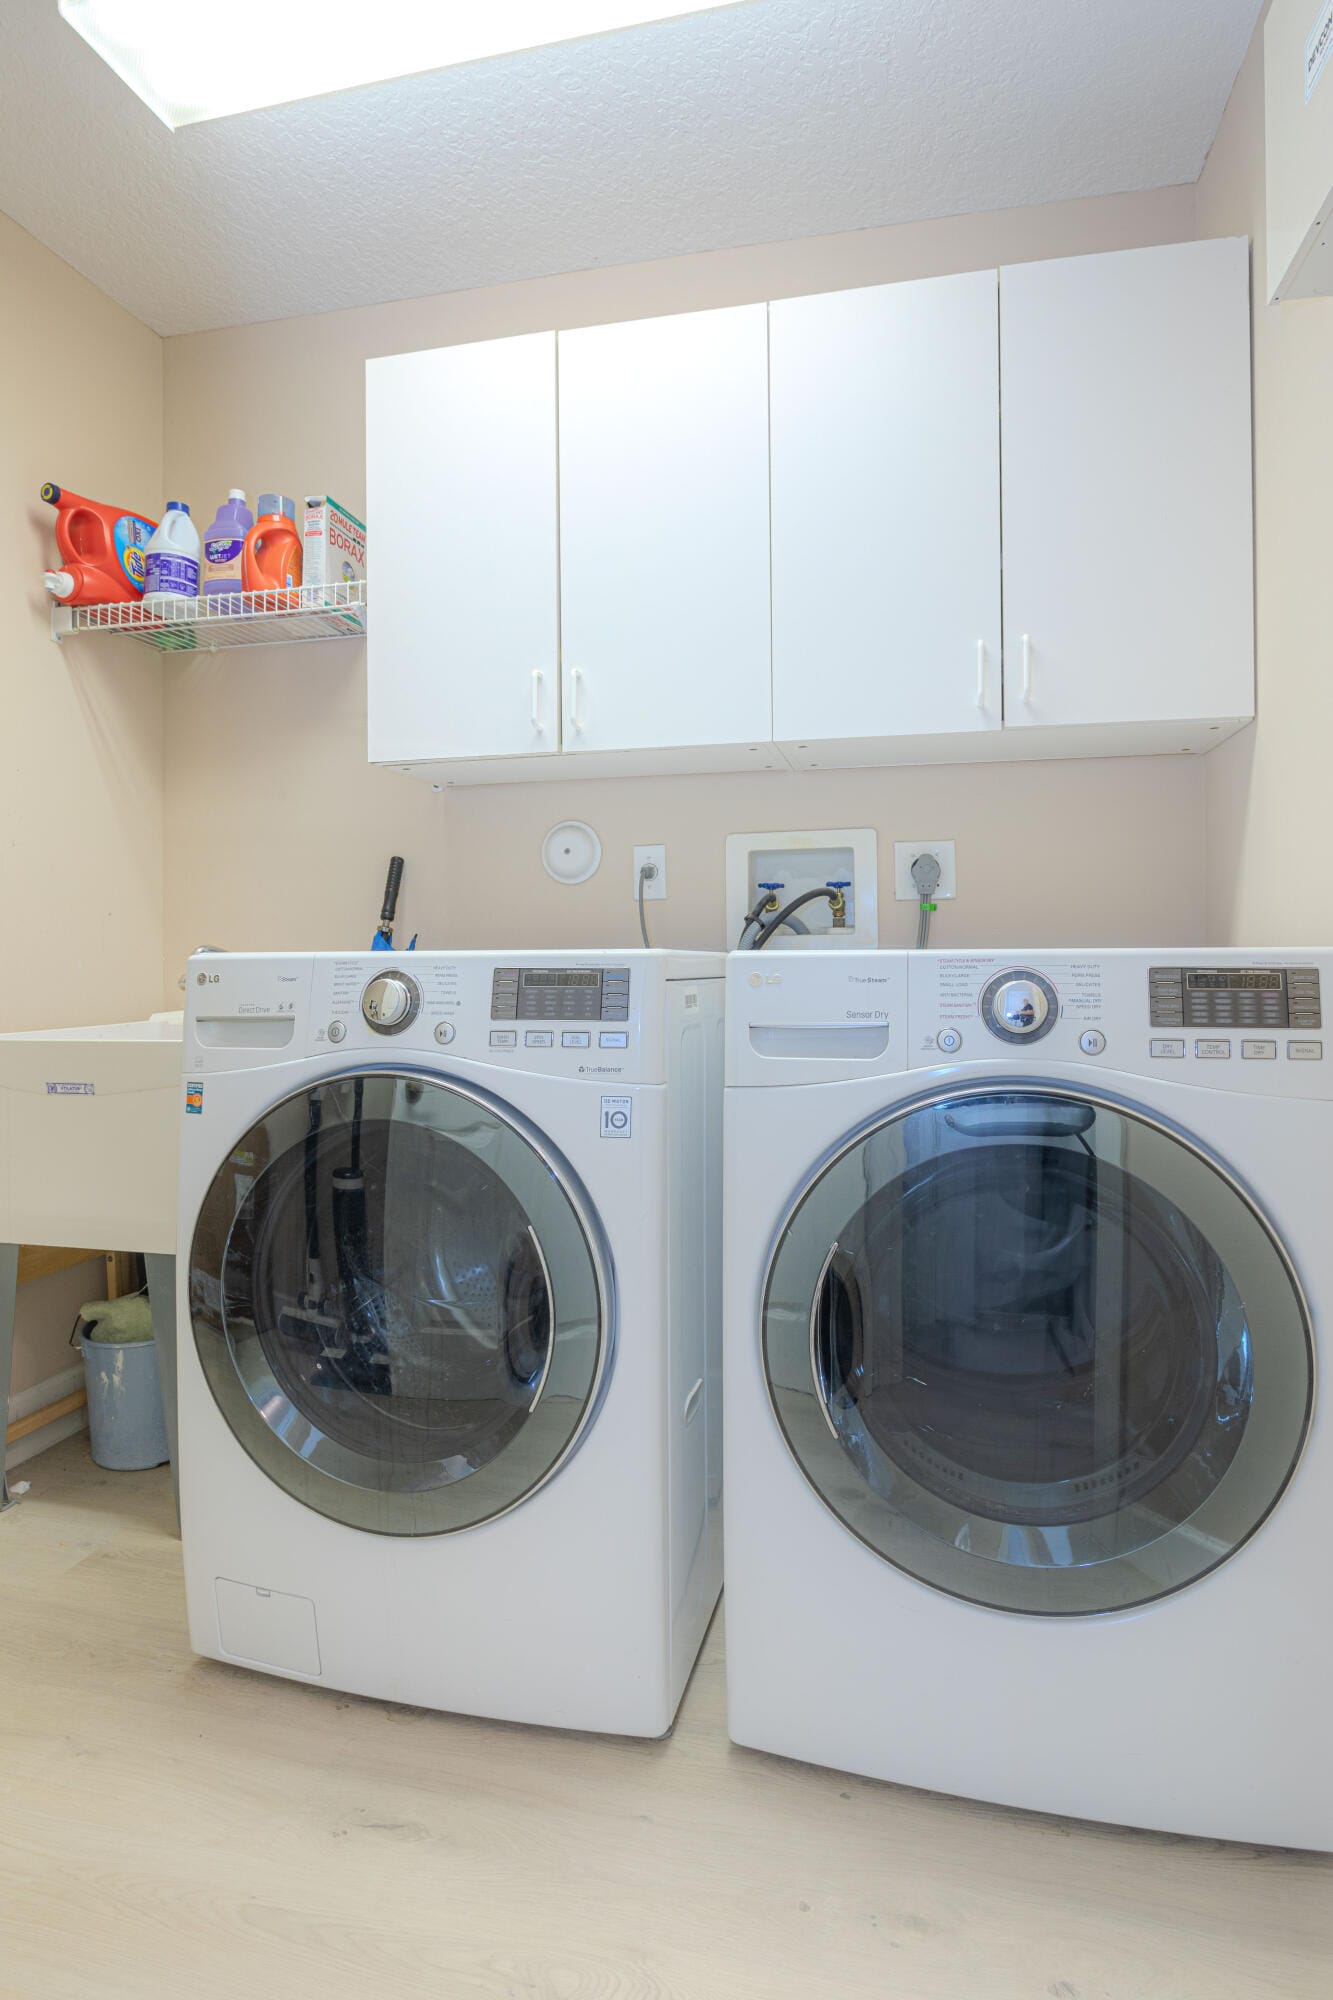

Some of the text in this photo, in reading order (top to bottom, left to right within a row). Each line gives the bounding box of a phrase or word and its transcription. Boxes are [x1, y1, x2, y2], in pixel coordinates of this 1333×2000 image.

[339, 515, 352, 534] MULE
[329, 527, 365, 569] BORAX
[130, 551, 145, 577] Tide
[208, 974, 220, 984] LG
[765, 974, 782, 985] LG
[846, 1010, 889, 1020] Sensor Dry
[604, 1110, 628, 1130] 10
